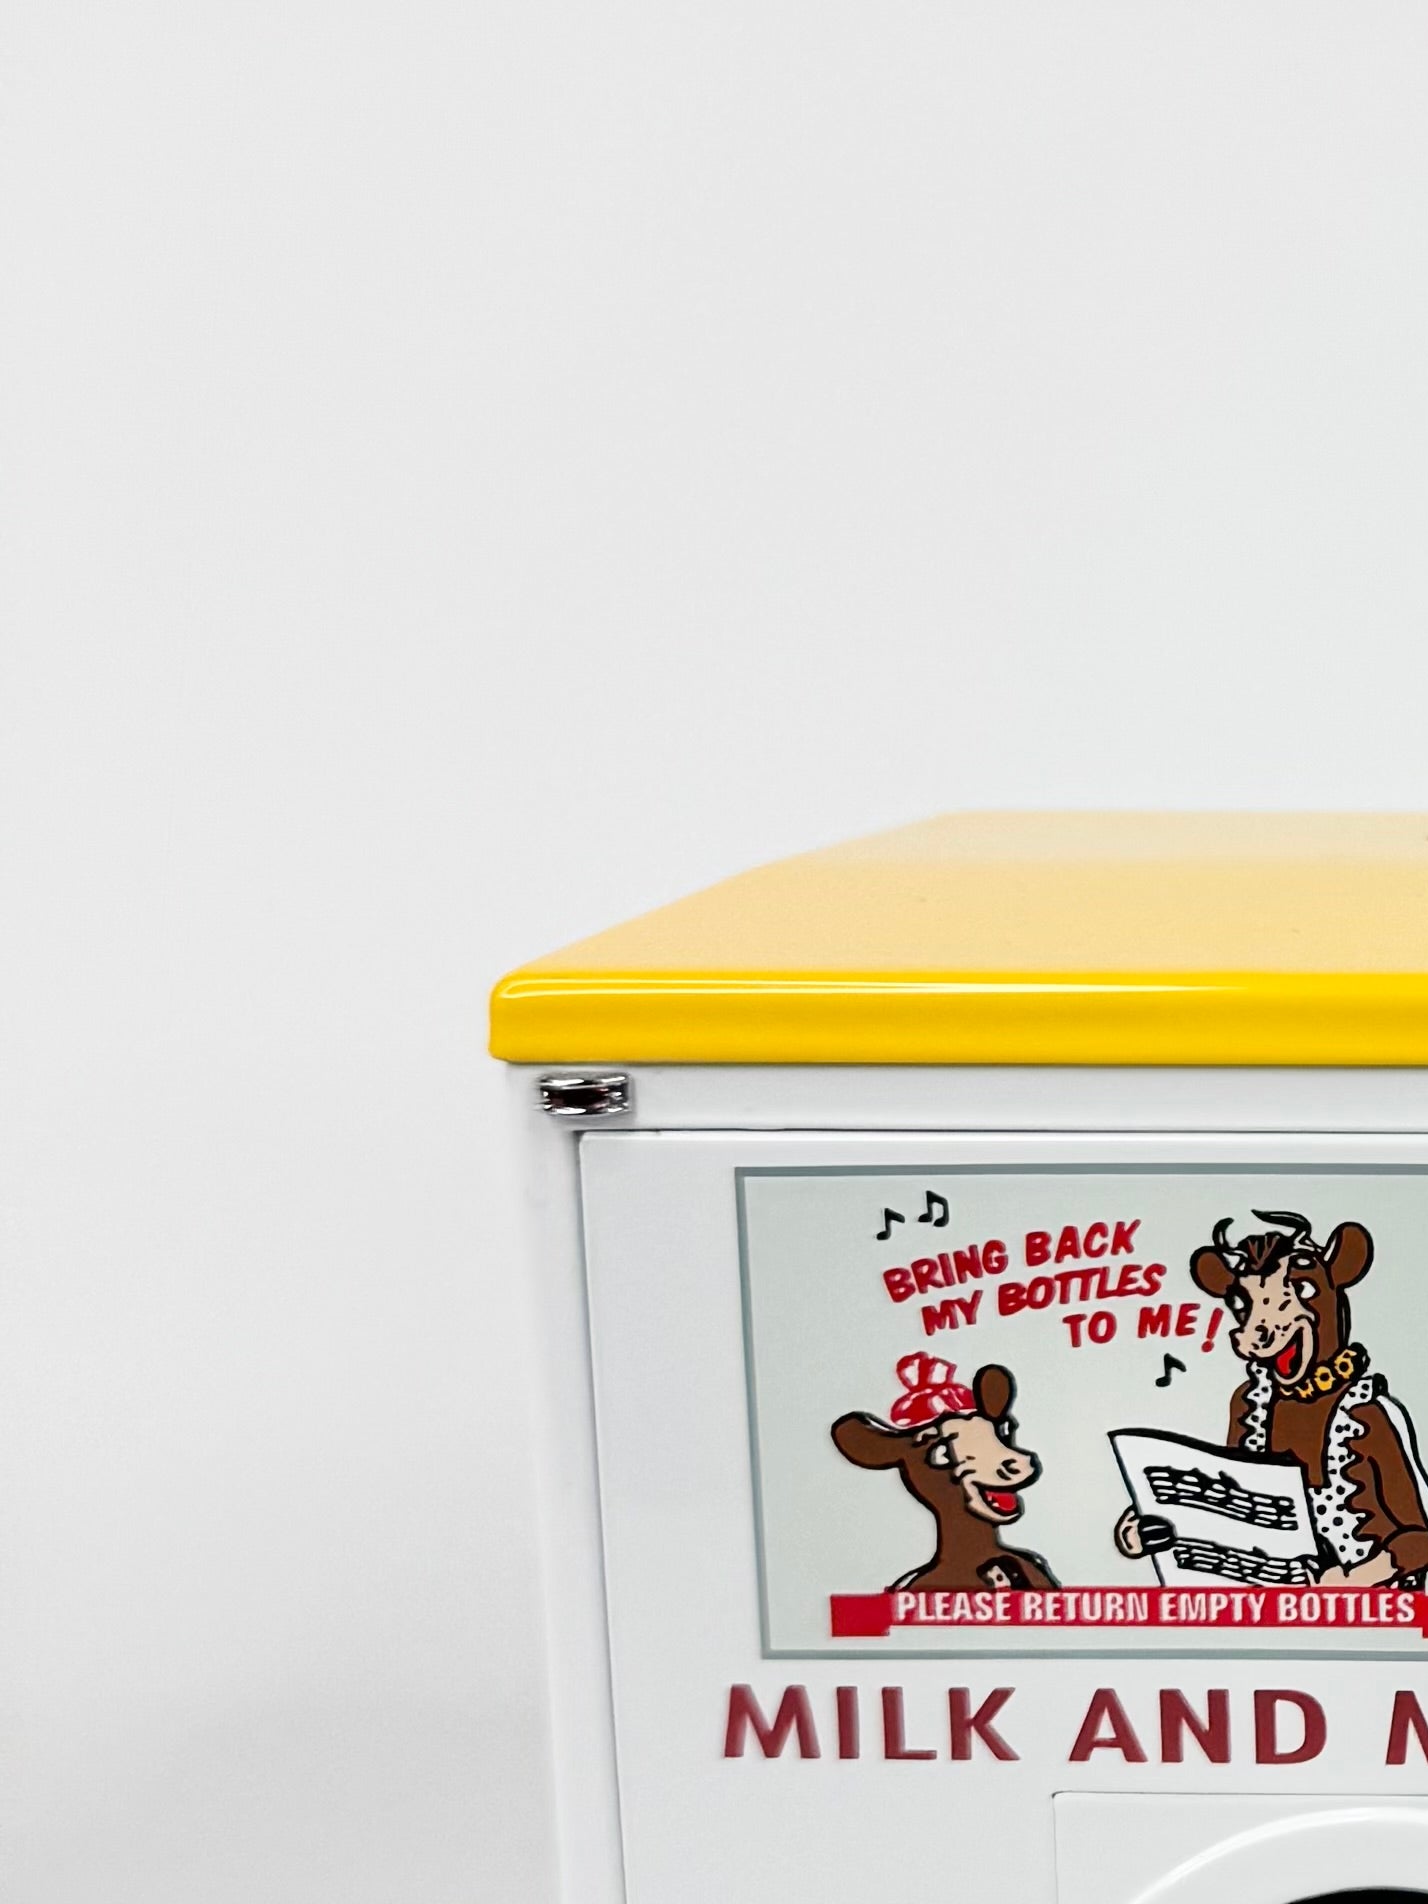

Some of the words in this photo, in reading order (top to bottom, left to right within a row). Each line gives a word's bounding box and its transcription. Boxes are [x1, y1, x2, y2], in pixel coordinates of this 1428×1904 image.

[883, 1239, 1009, 1303] BRING
[1025, 1218, 1142, 1267] BACK
[921, 1289, 984, 1336] MY
[998, 1263, 1168, 1316] BOTTLES
[1062, 1310, 1118, 1348] TO
[1136, 1302, 1224, 1353] ME!
[896, 1593, 1011, 1622] PLEASE
[1023, 1593, 1148, 1622] RETURN
[1159, 1593, 1266, 1623] EMPTY
[1278, 1593, 1416, 1624] BOTTLES
[722, 1684, 1021, 1761] MILK
[1068, 1688, 1328, 1764] AND
